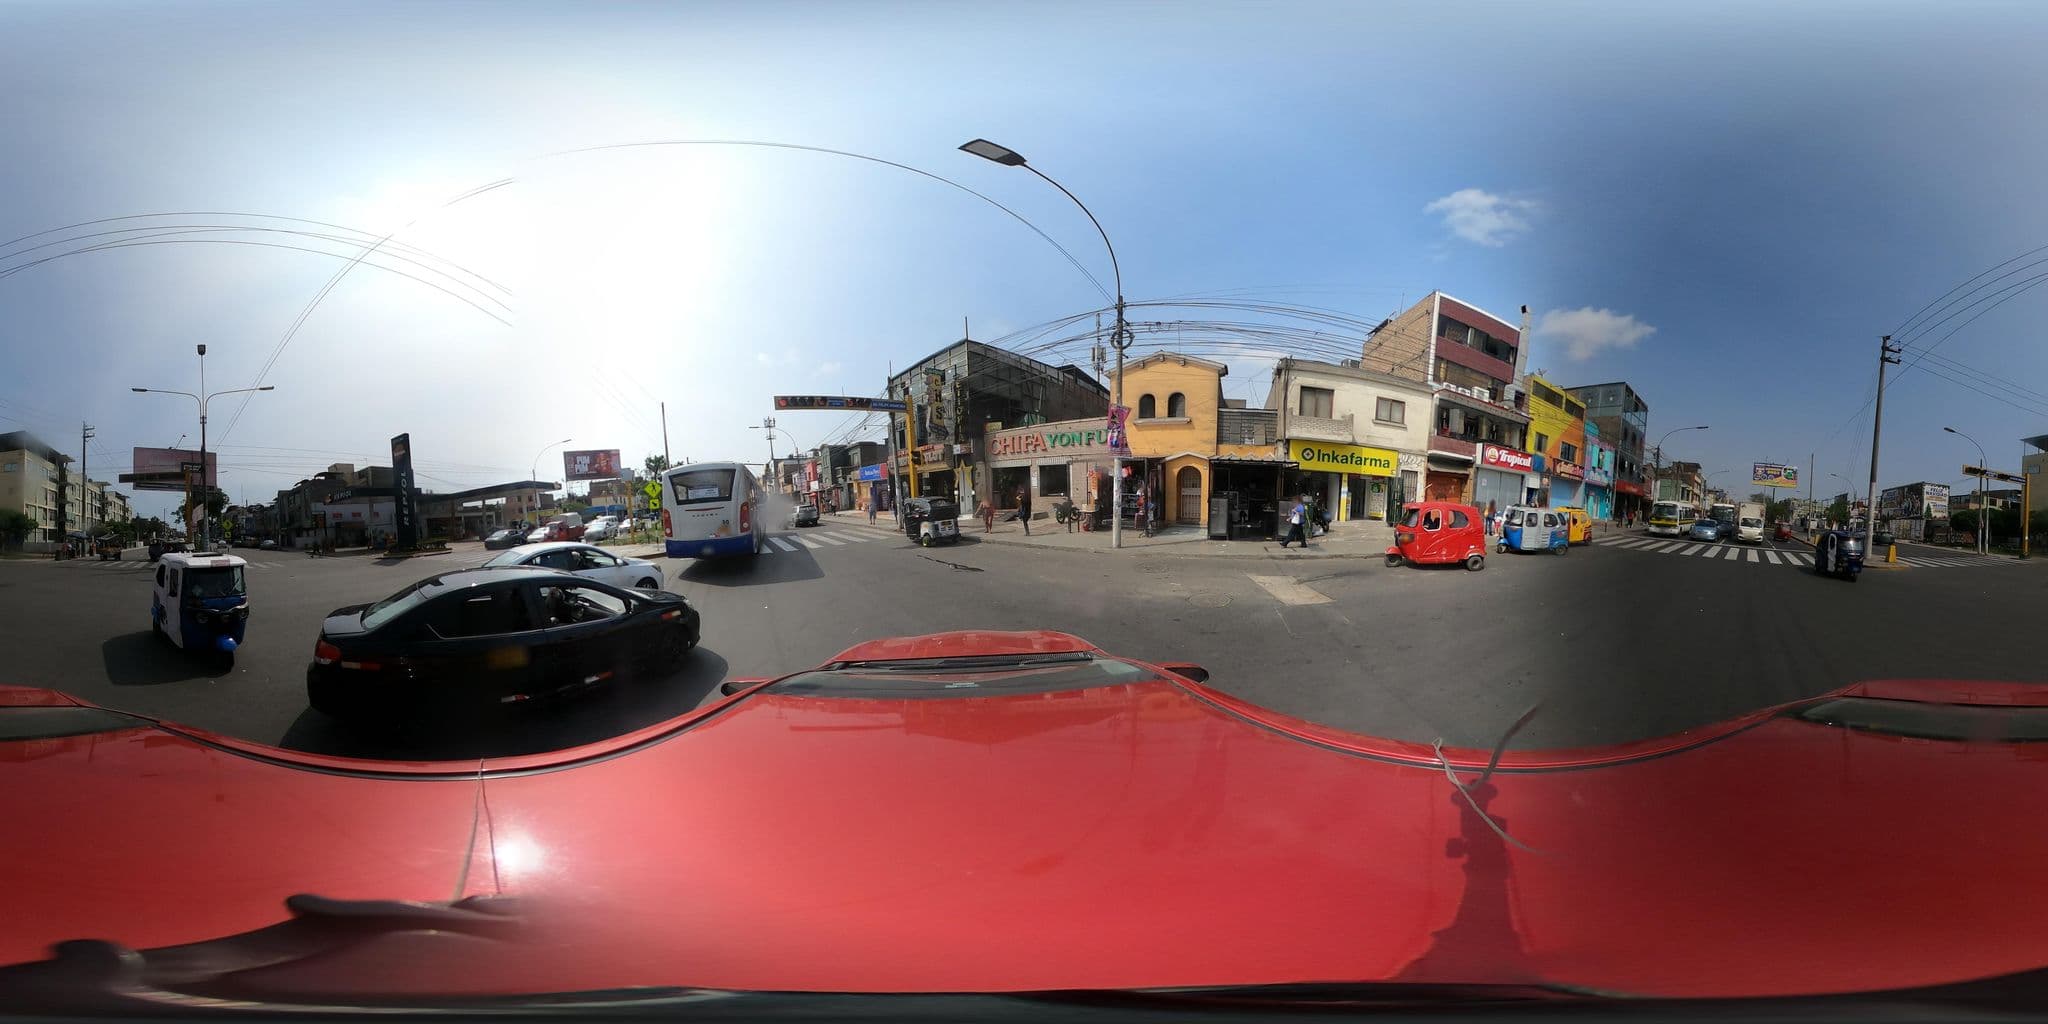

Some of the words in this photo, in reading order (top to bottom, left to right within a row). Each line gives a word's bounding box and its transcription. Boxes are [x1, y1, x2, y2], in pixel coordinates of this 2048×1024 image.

[989, 432, 1048, 455] CHIFA
[1317, 449, 1391, 468] Inkafarma
[1500, 449, 1532, 468] Tropical
[400, 471, 409, 526] REPSOL
